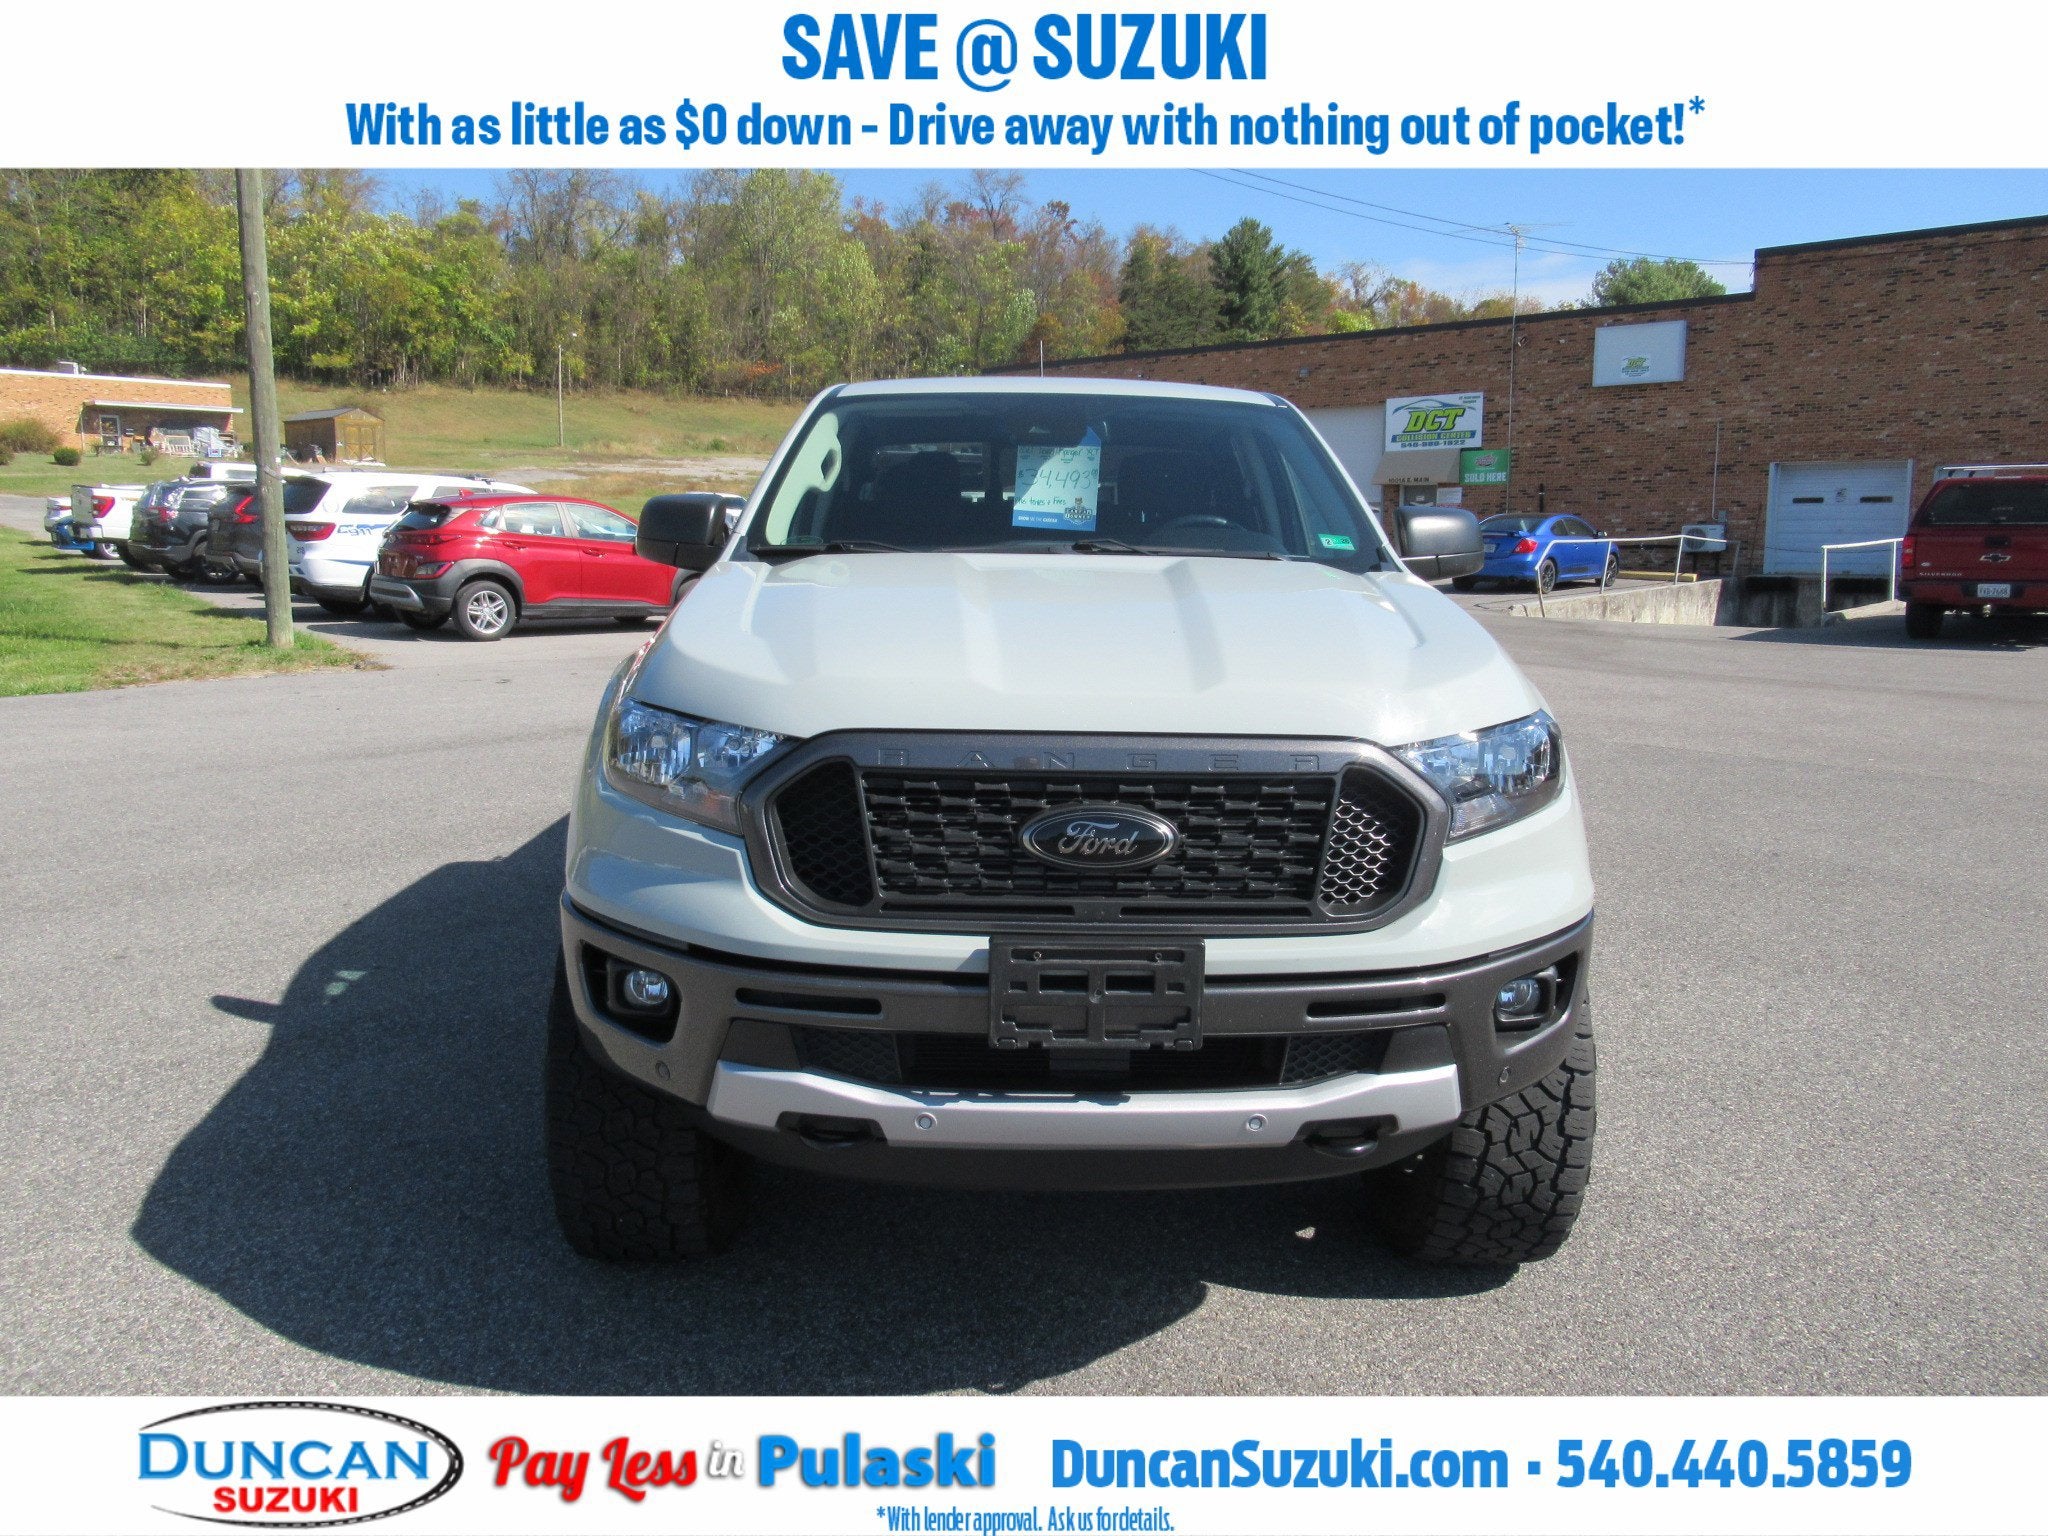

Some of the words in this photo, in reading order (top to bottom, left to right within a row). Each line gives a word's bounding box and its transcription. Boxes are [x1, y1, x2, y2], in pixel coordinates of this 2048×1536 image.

[1402, 407, 1466, 433] DCT
[1464, 473, 1485, 483] SOLD
[1486, 472, 1507, 482] HERE
[877, 748, 1320, 771] RANGER
[1057, 821, 1138, 855] Ford
